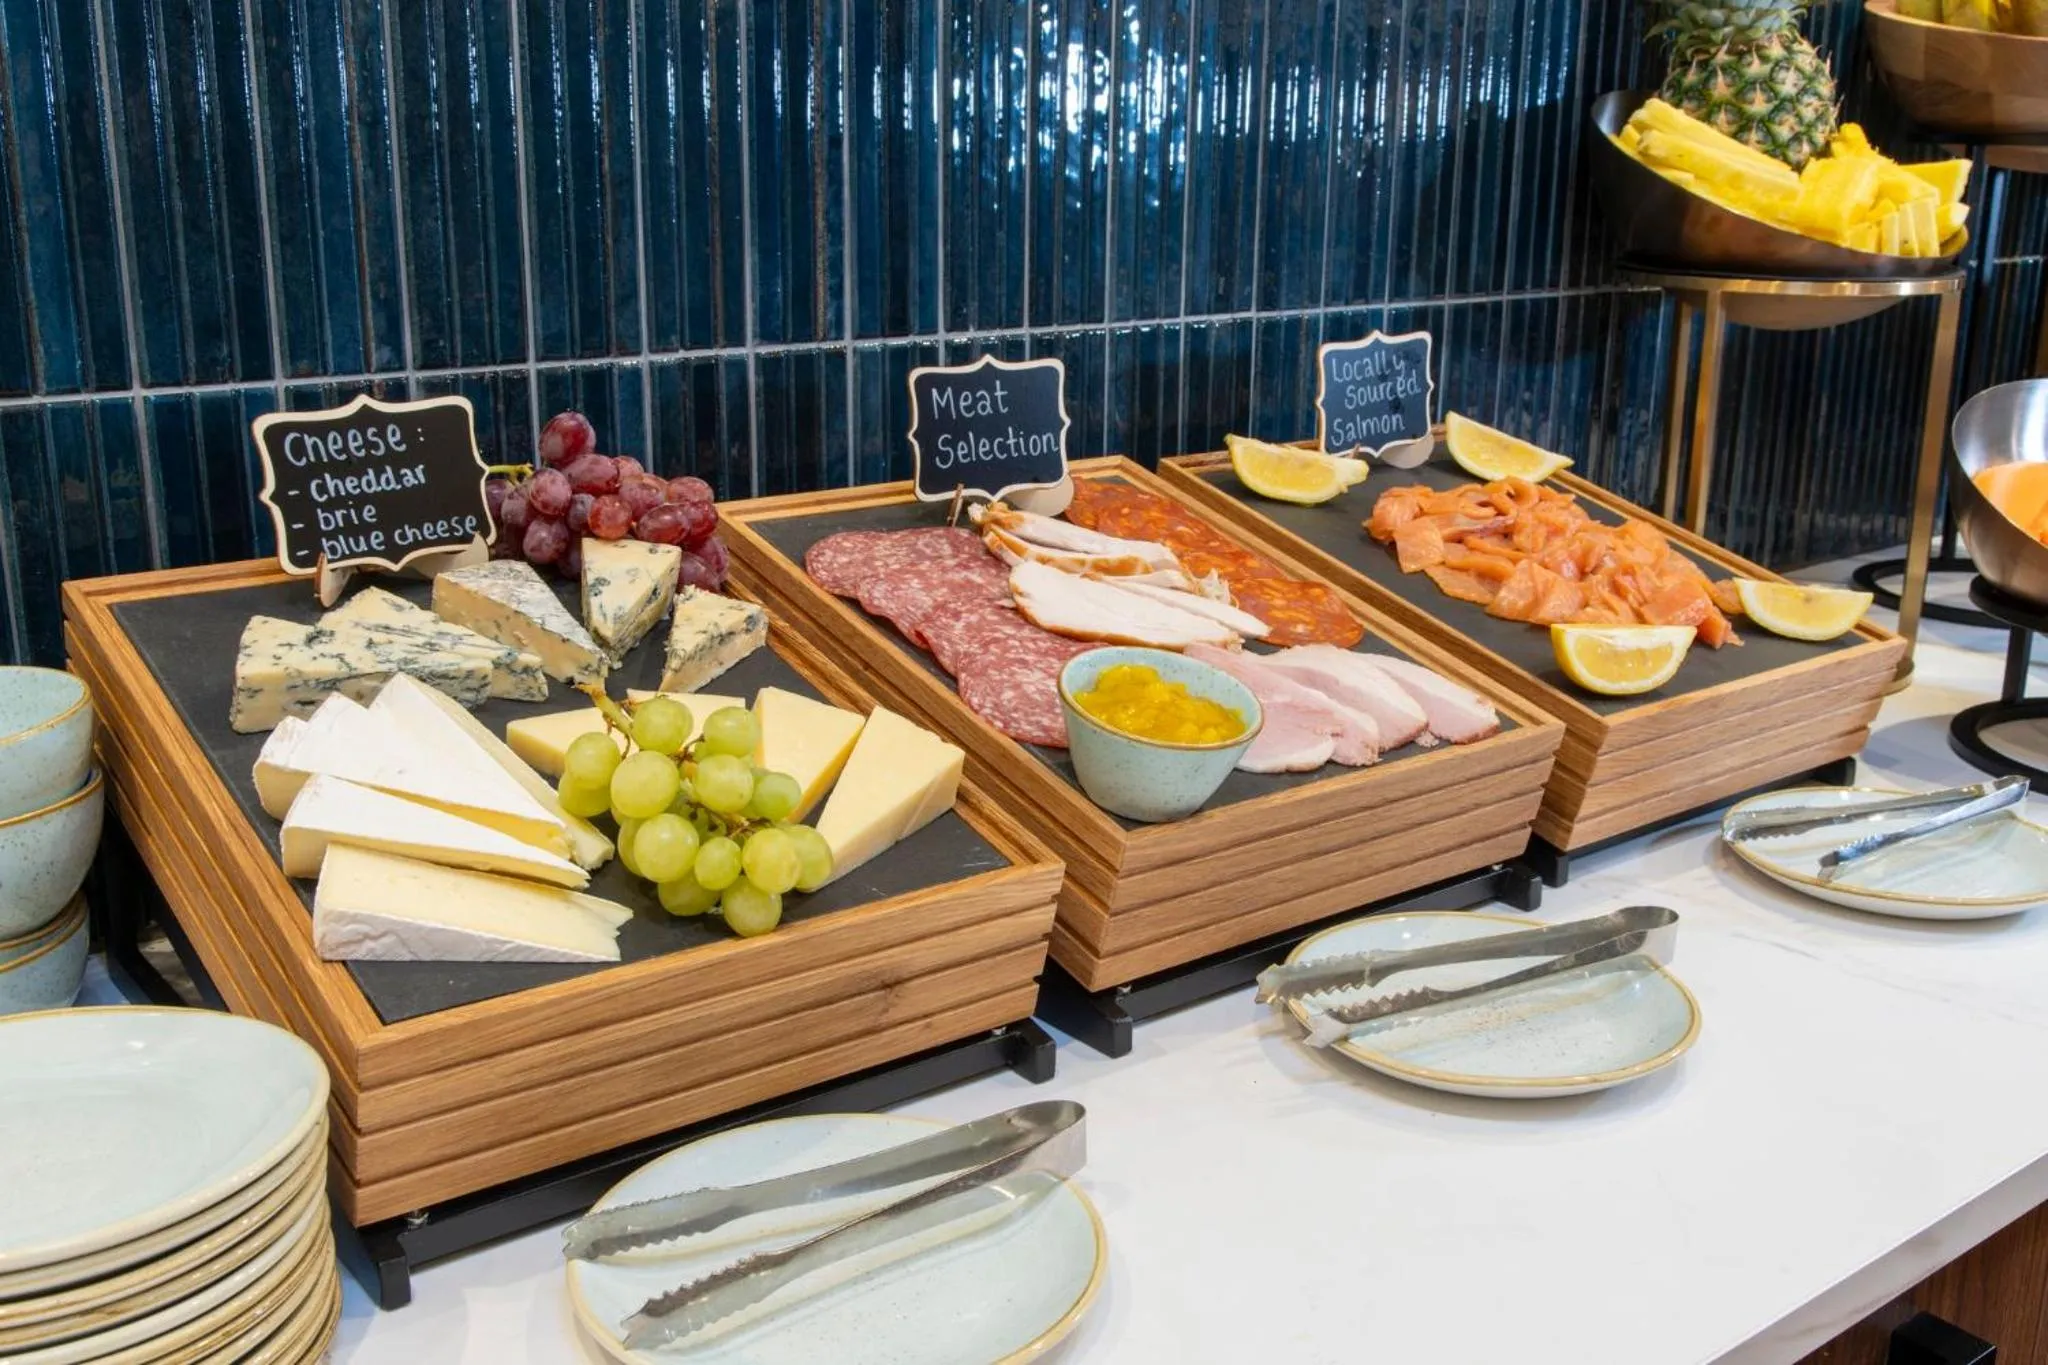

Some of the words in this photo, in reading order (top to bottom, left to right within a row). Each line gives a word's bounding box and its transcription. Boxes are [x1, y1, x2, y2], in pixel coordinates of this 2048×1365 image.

[931, 380, 1009, 420] Meat
[935, 426, 1059, 469] Selection
[1331, 413, 1406, 446] Salmon
[317, 501, 378, 532] brie
[321, 530, 386, 560] blue
[394, 515, 477, 546] cheese
